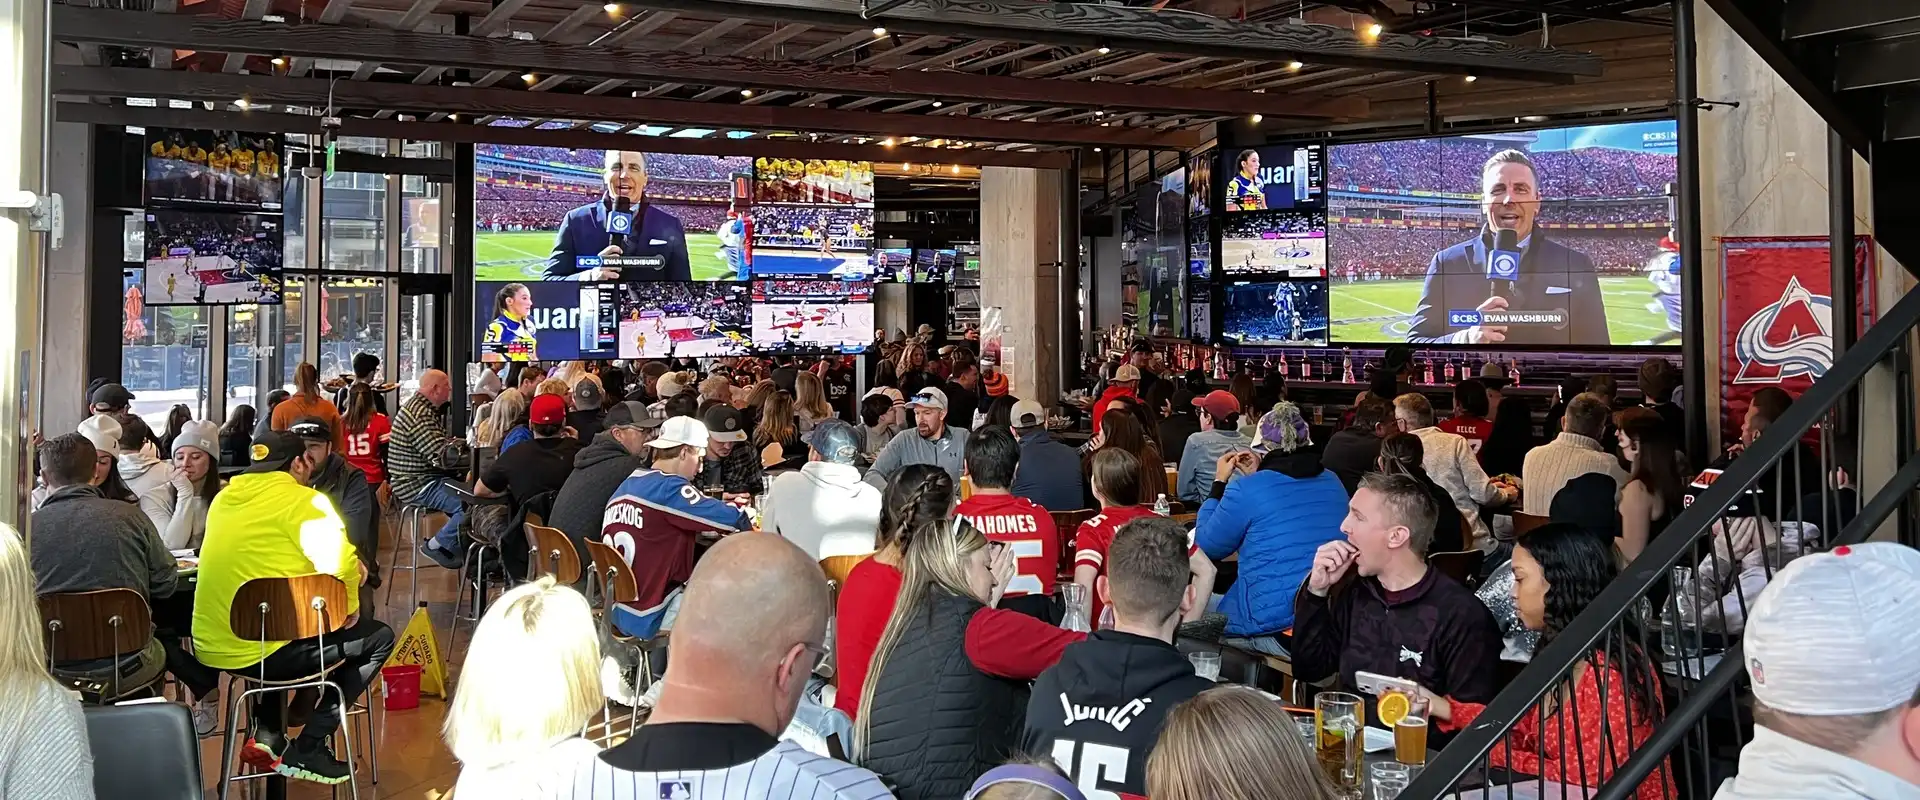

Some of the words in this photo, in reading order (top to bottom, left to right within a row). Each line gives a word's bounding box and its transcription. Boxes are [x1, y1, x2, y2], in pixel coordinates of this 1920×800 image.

[1261, 165, 1294, 184] uar
[533, 307, 580, 329] uar
[1456, 425, 1477, 434] KELCE
[347, 433, 370, 455] 15
[395, 633, 414, 661] ATTENTION
[420, 633, 433, 665] CUIDADO
[1051, 740, 1130, 800] 15
